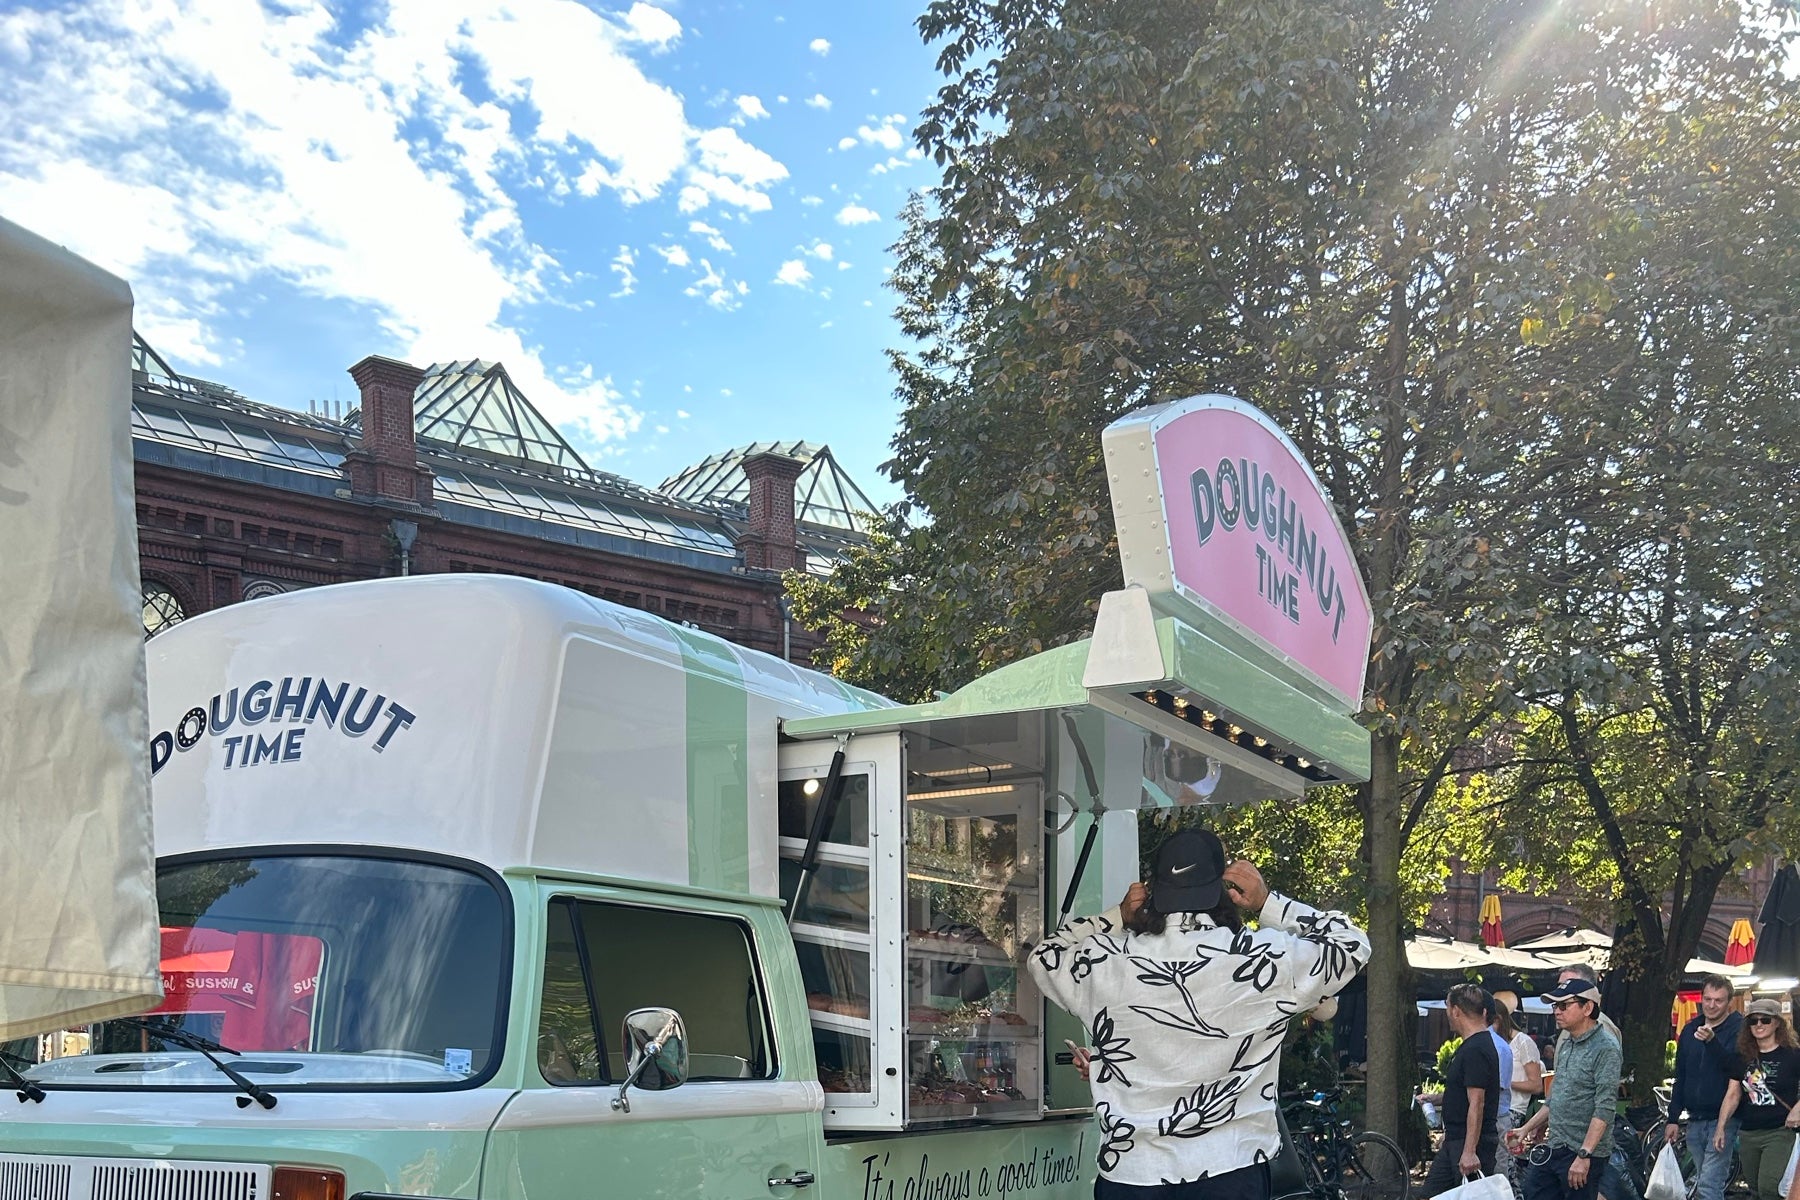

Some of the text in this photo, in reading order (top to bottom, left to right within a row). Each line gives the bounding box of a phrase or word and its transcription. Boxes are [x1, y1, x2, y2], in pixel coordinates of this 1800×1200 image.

[1190, 458, 1346, 646] DOUGHNUT
[1256, 543, 1300, 626] TIME
[150, 677, 417, 777] DOUGHNUT
[223, 728, 306, 770] TIME
[978, 1167, 992, 1197] a
[1042, 1131, 1084, 1187] time!
